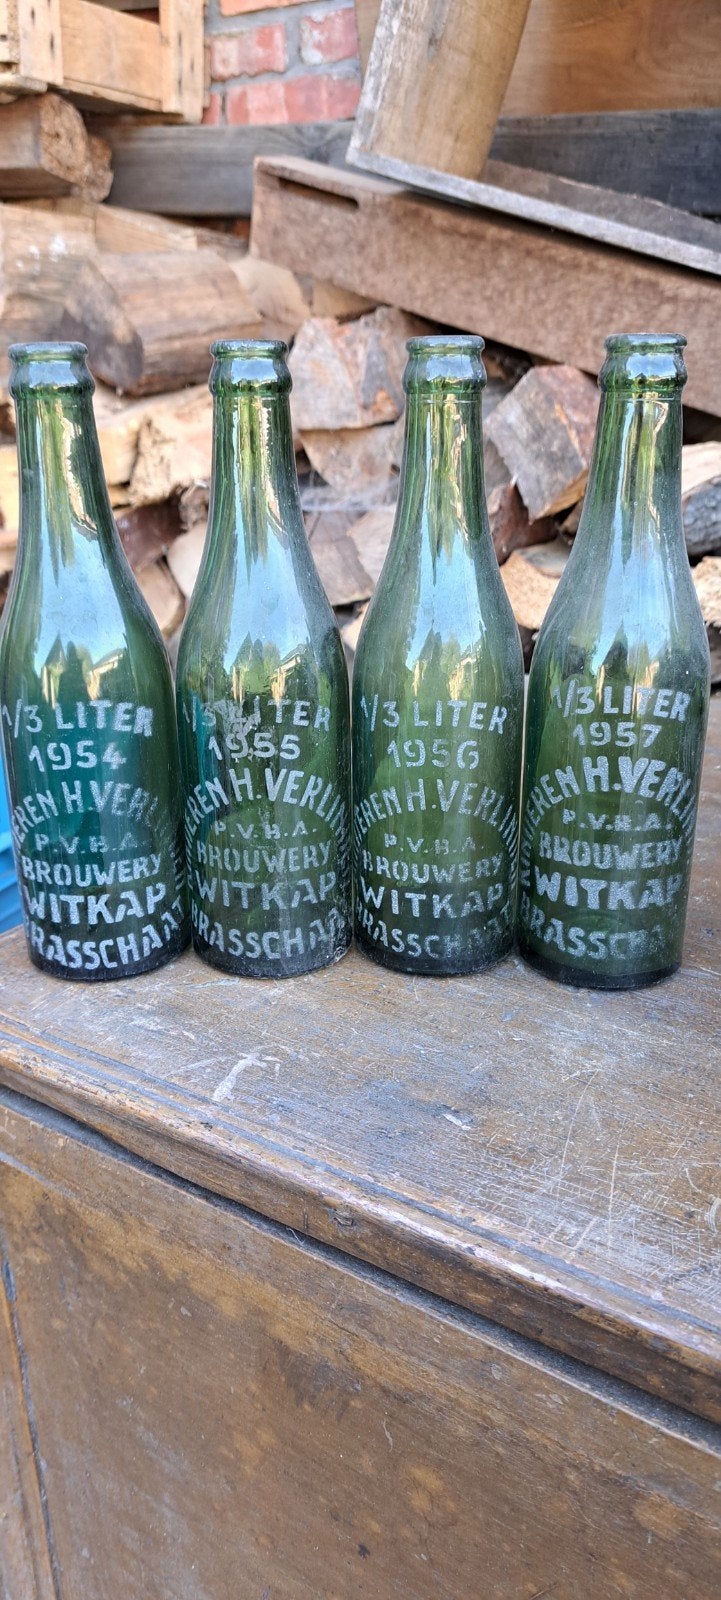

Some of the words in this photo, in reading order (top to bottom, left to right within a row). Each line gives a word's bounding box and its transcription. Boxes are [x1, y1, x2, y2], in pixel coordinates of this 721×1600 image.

[56, 700, 153, 737] LITER
[360, 694, 400, 732] 1/3
[413, 700, 508, 734] LITER
[551, 680, 596, 718] 1/3
[603, 686, 690, 722] LITER
[208, 733, 301, 760] 1955
[572, 721, 662, 748] 1957
[28, 740, 127, 772] 1954
[387, 738, 480, 770] 1956
[12, 789, 59, 850] EREN
[21, 853, 161, 887] BROUWERY
[197, 839, 331, 874] BROUWERY
[362, 853, 502, 884] BROUWERY
[539, 832, 682, 870] BROUWERY
[24, 882, 167, 925] WITKAP
[195, 869, 337, 911] WITKAP
[360, 875, 503, 919] WITKAP
[534, 865, 683, 911] WITKAP
[26, 898, 185, 970] RASSCHAAT
